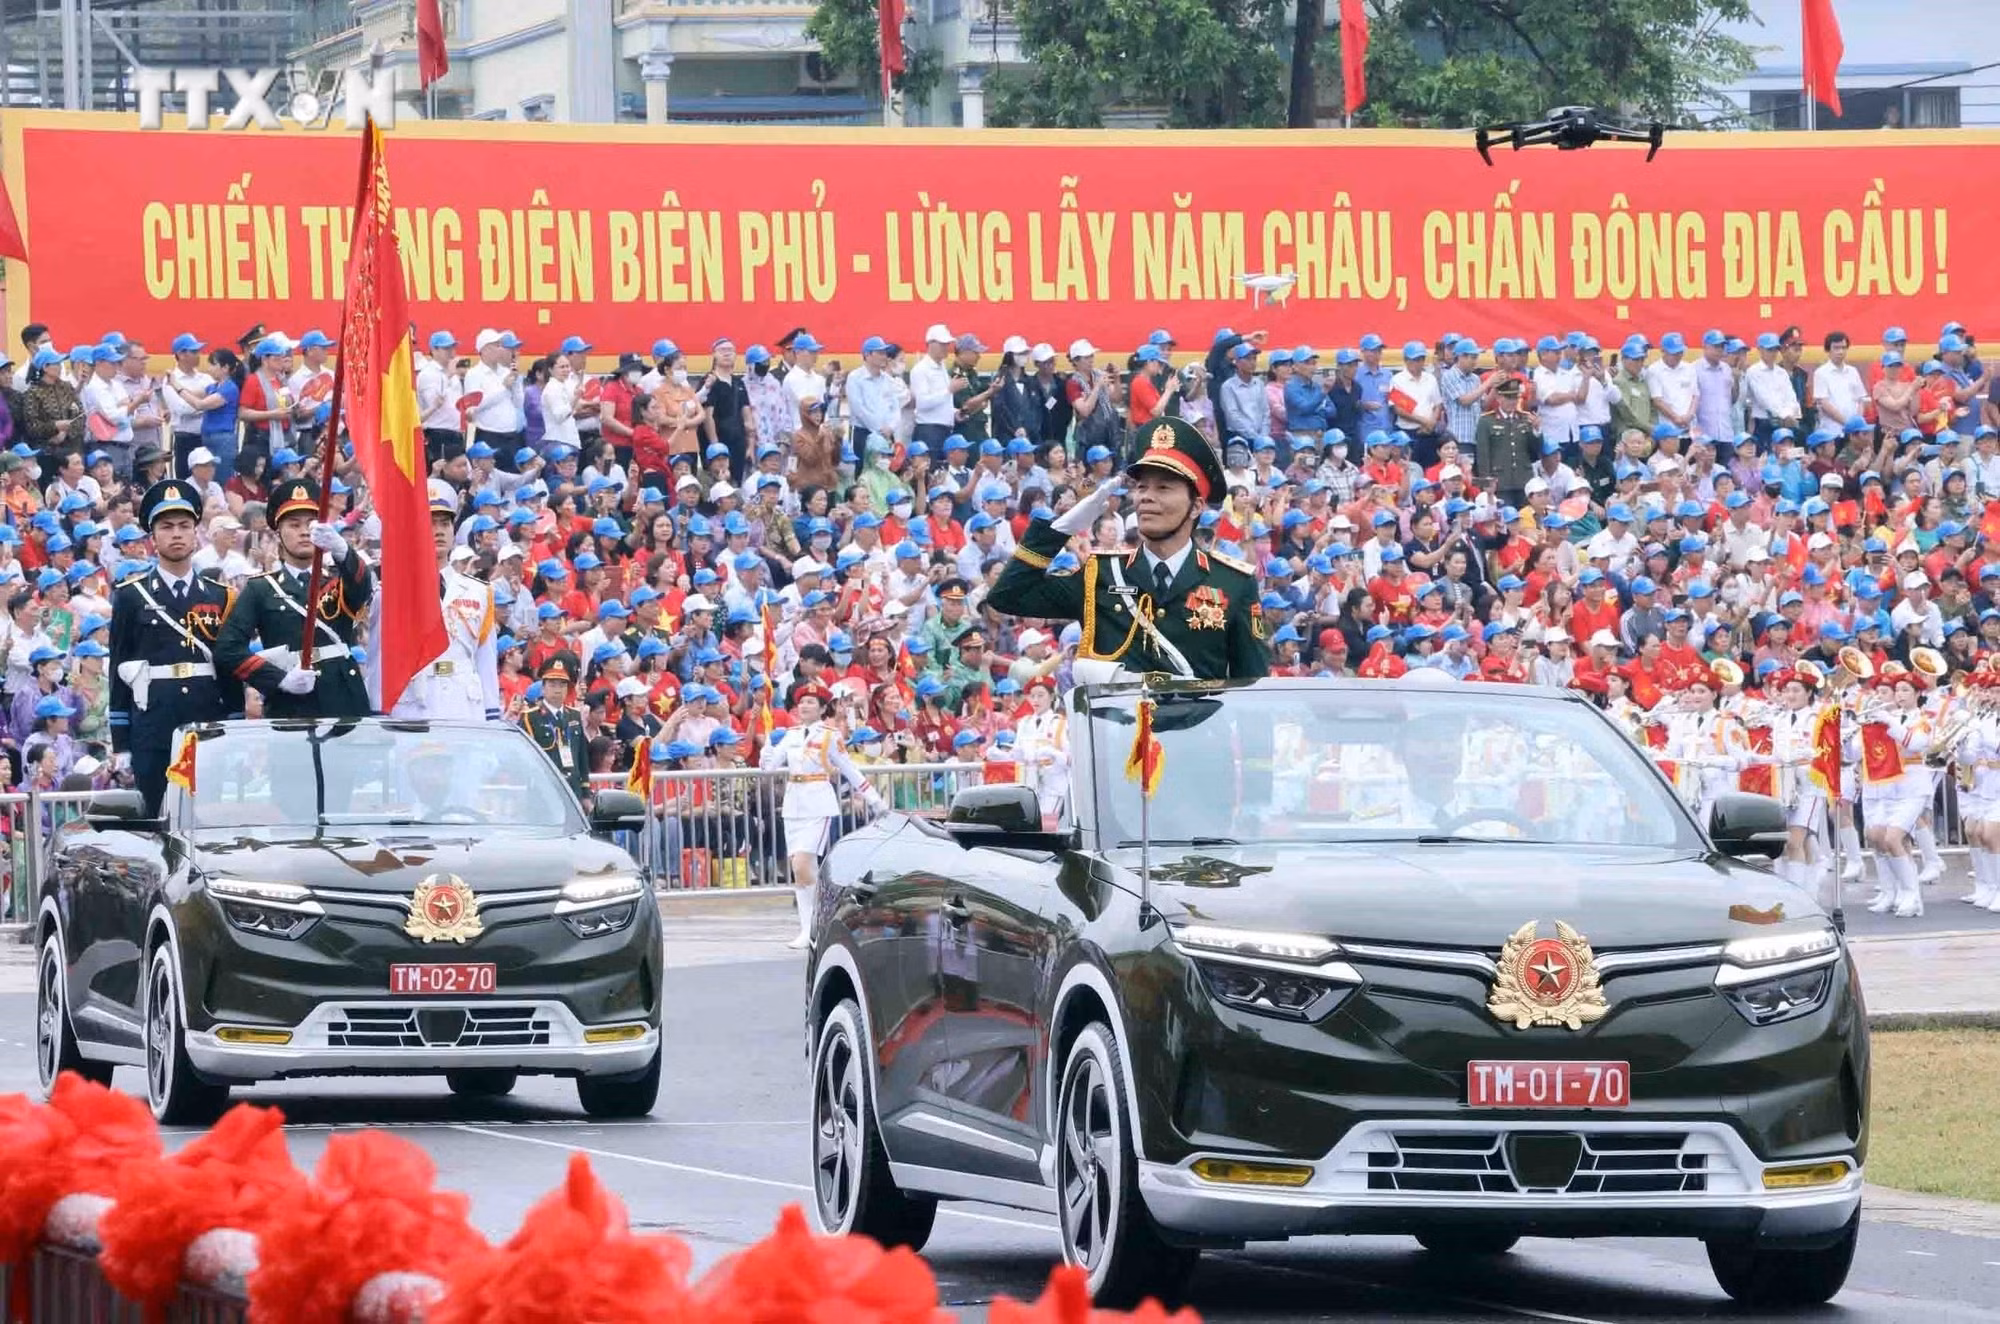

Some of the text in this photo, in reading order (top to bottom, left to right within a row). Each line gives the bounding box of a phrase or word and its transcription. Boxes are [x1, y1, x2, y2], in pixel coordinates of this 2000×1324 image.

[143, 172, 290, 300] CHIẾN
[301, 206, 465, 302] THNG
[477, 188, 594, 325] ĐIỆN
[608, 190, 725, 303] BIÊN
[738, 179, 837, 303] PHỦ
[885, 191, 1014, 303] LỪNG
[1028, 175, 1116, 302] LẪY
[1131, 191, 1247, 301] NĂM
[1262, 191, 1408, 312] CHÂU,
[1423, 179, 1556, 300] CHẤN
[1570, 192, 1707, 320] ĐỘNG
[1721, 210, 1808, 318] ĐỊA
[394, 966, 493, 991] TM-02-70
[1474, 1065, 1624, 1104] TM-01-70
